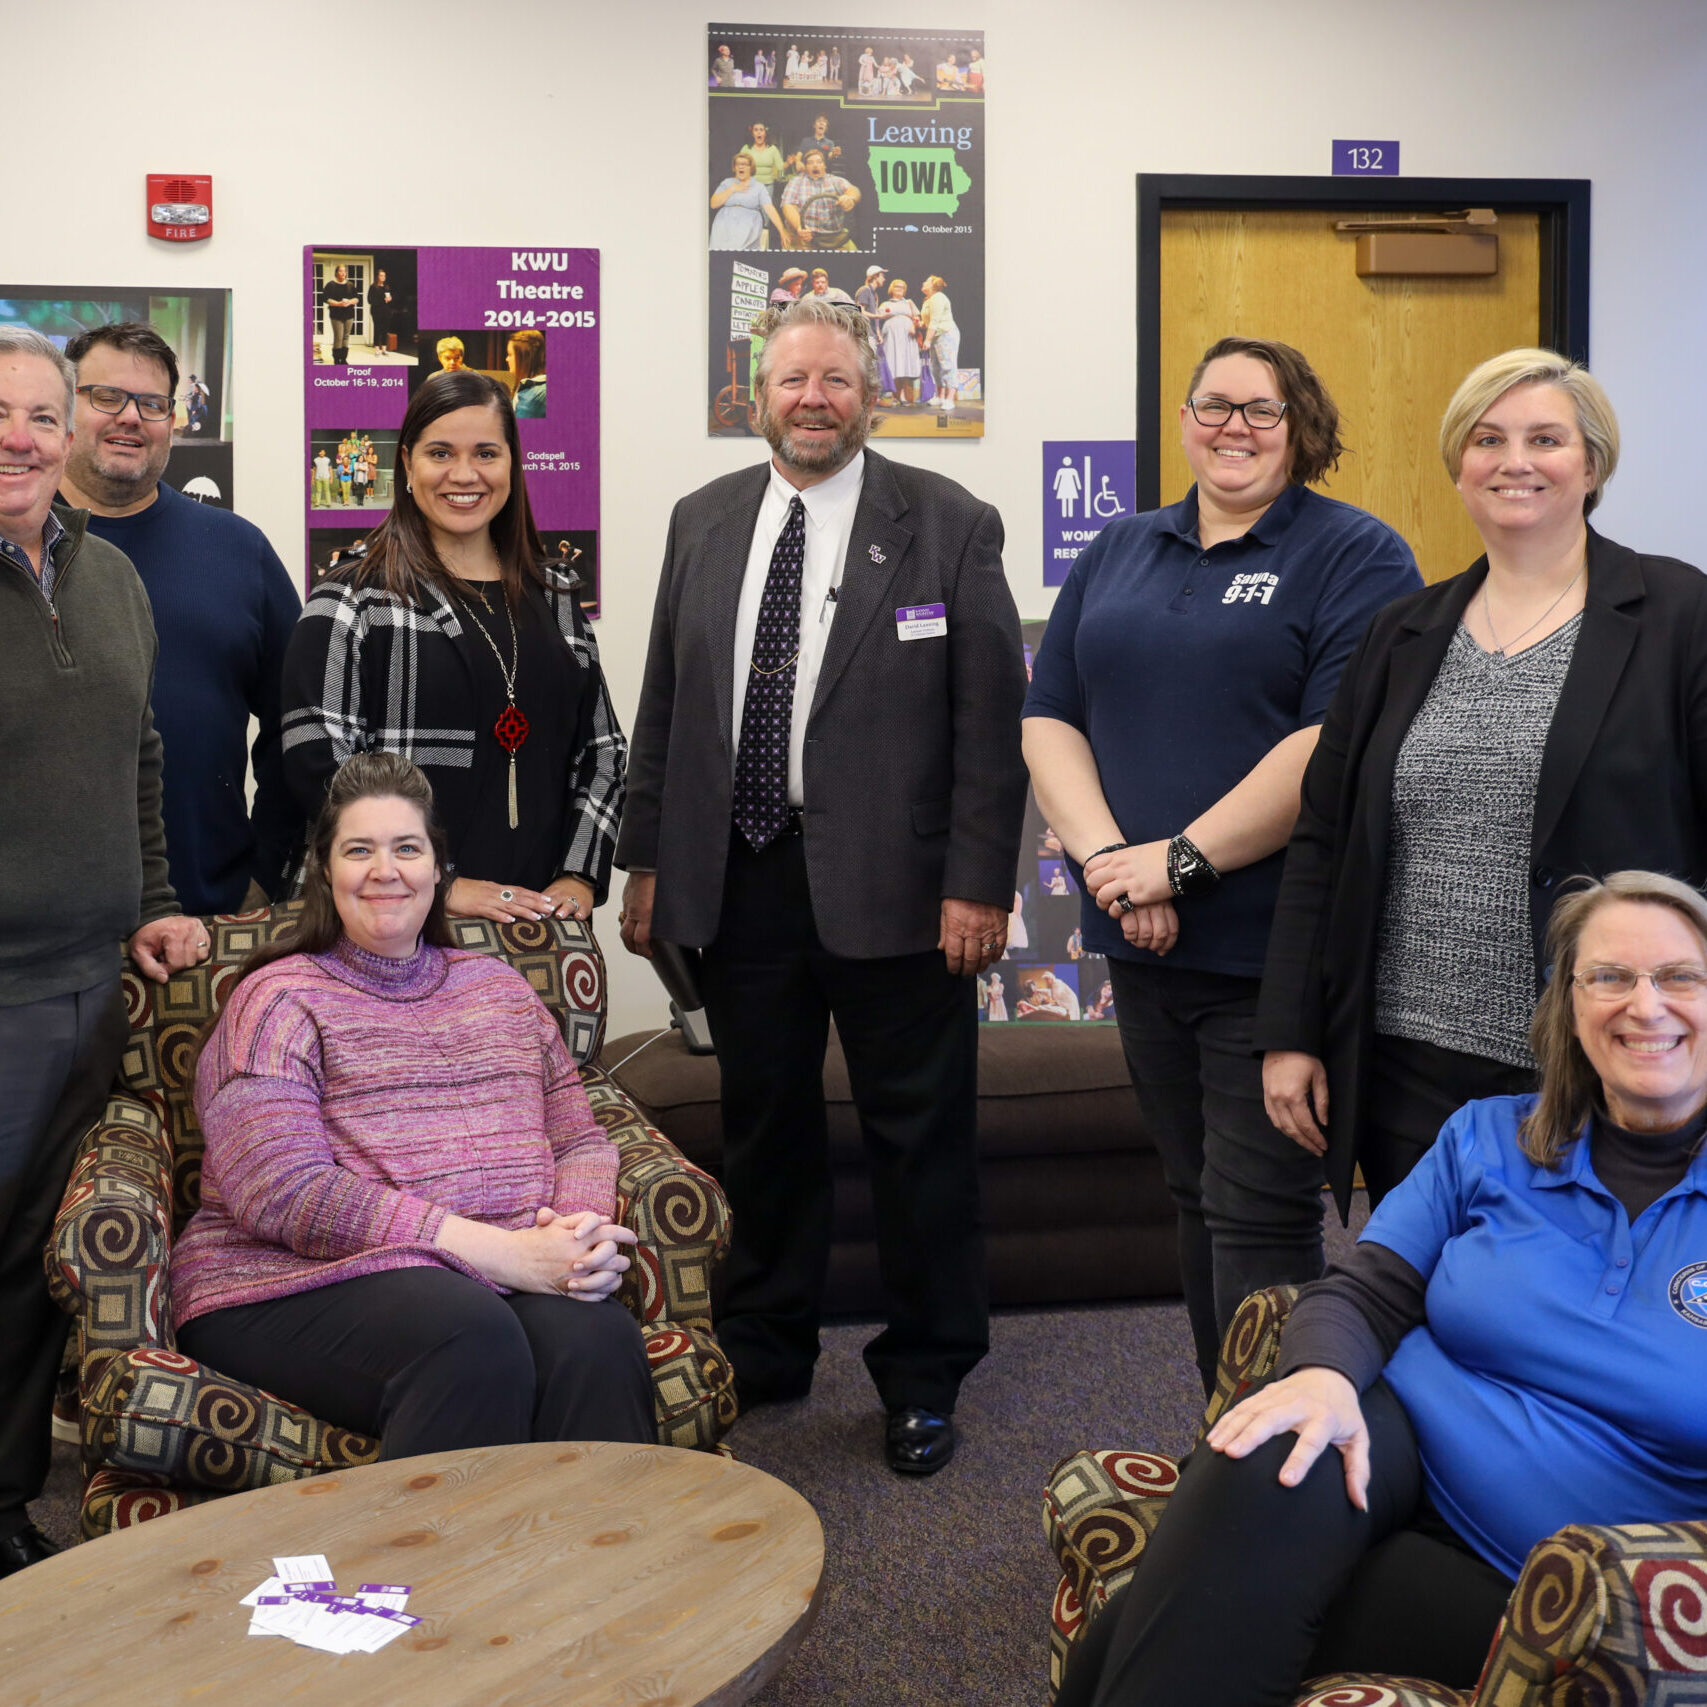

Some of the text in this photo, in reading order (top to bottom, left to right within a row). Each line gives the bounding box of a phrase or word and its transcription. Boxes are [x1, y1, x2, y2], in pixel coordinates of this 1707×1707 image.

[867, 117, 972, 150] Leaving
[1347, 147, 1383, 169] 132
[880, 160, 953, 194] IOWA
[166, 228, 197, 238] FIRE
[922, 225, 972, 234] October 2015
[511, 252, 568, 271] KWU
[496, 280, 584, 299] Theatre
[484, 310, 596, 328] 2014-2015
[347, 367, 371, 376] Proof
[314, 378, 403, 388] October 16-19, 2014
[527, 452, 565, 461] Godspell
[540, 462, 556, 471] 5-8,
[559, 462, 580, 470] 2015
[1222, 583, 1276, 605] 9-1-1
